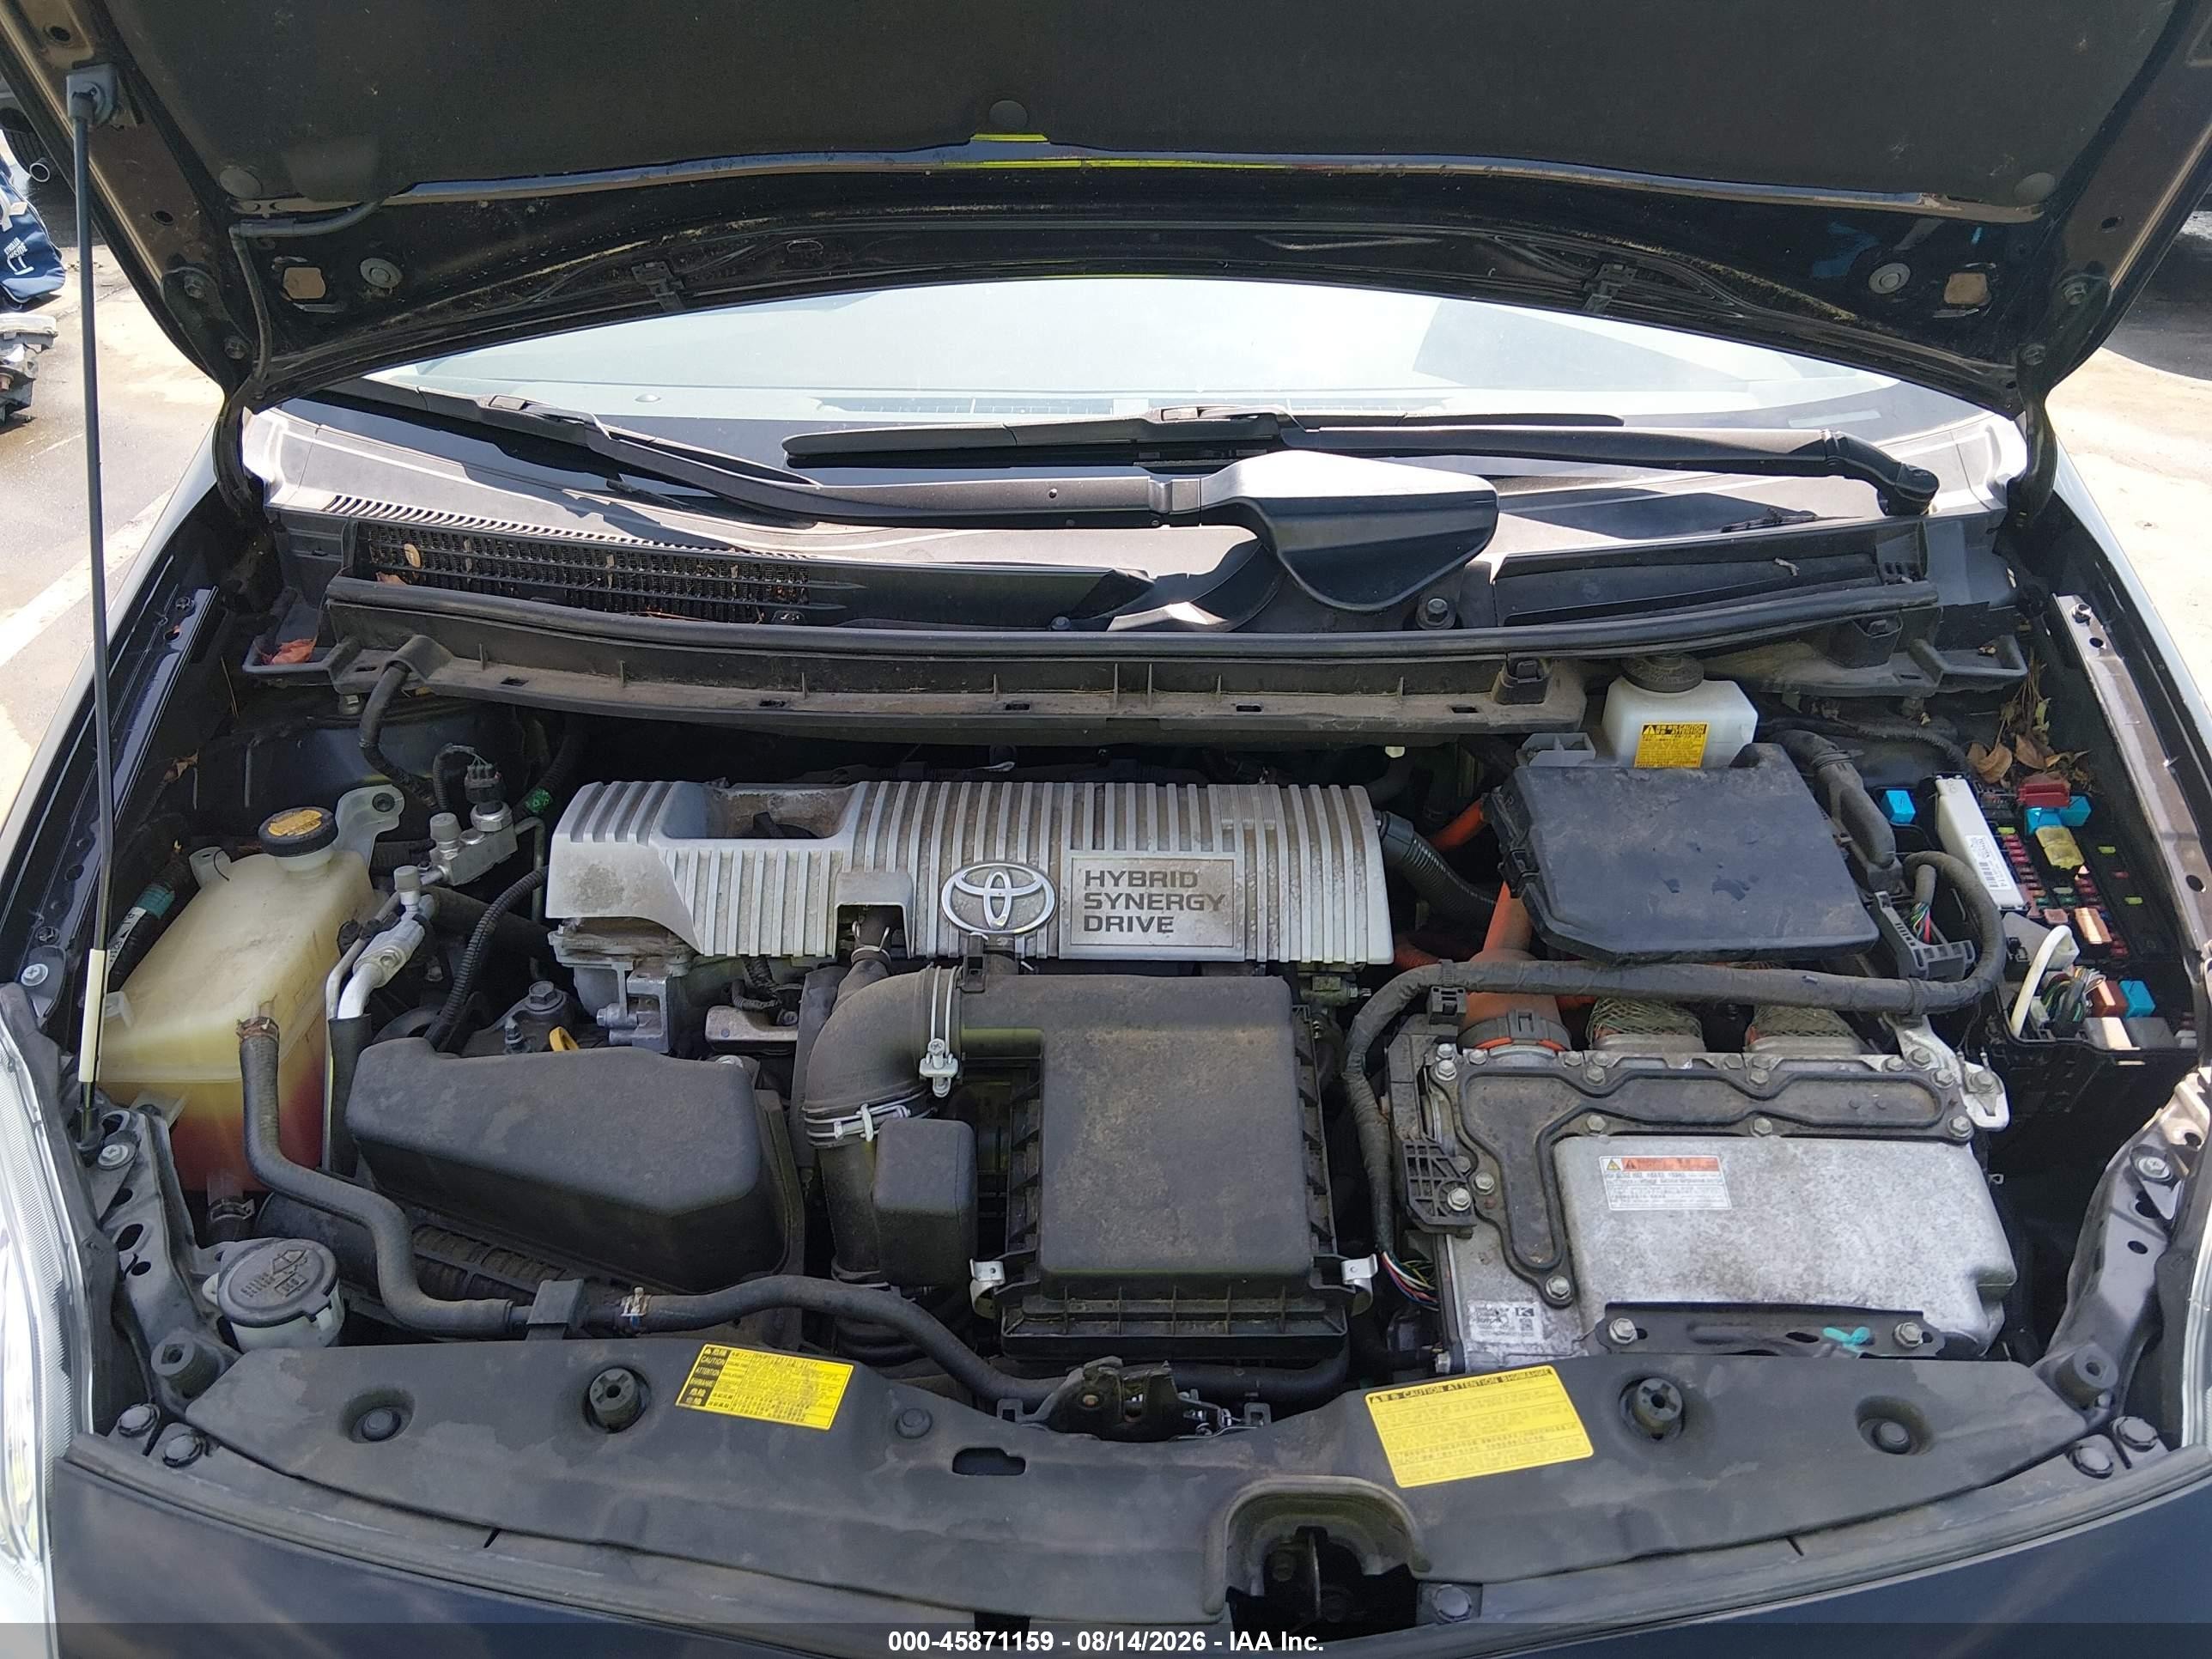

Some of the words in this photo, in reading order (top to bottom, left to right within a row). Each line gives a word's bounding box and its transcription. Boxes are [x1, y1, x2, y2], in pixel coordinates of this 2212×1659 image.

[1085, 870, 1198, 888] HYBRID
[1084, 893, 1226, 911] SYNERGY
[1084, 915, 1175, 933] DRIVE
[701, 1355, 725, 1365] CAUTION
[695, 1366, 720, 1376] ATTENTION
[1402, 1384, 1444, 1398] CAUTION
[1447, 1376, 1499, 1391] ATTENTION
